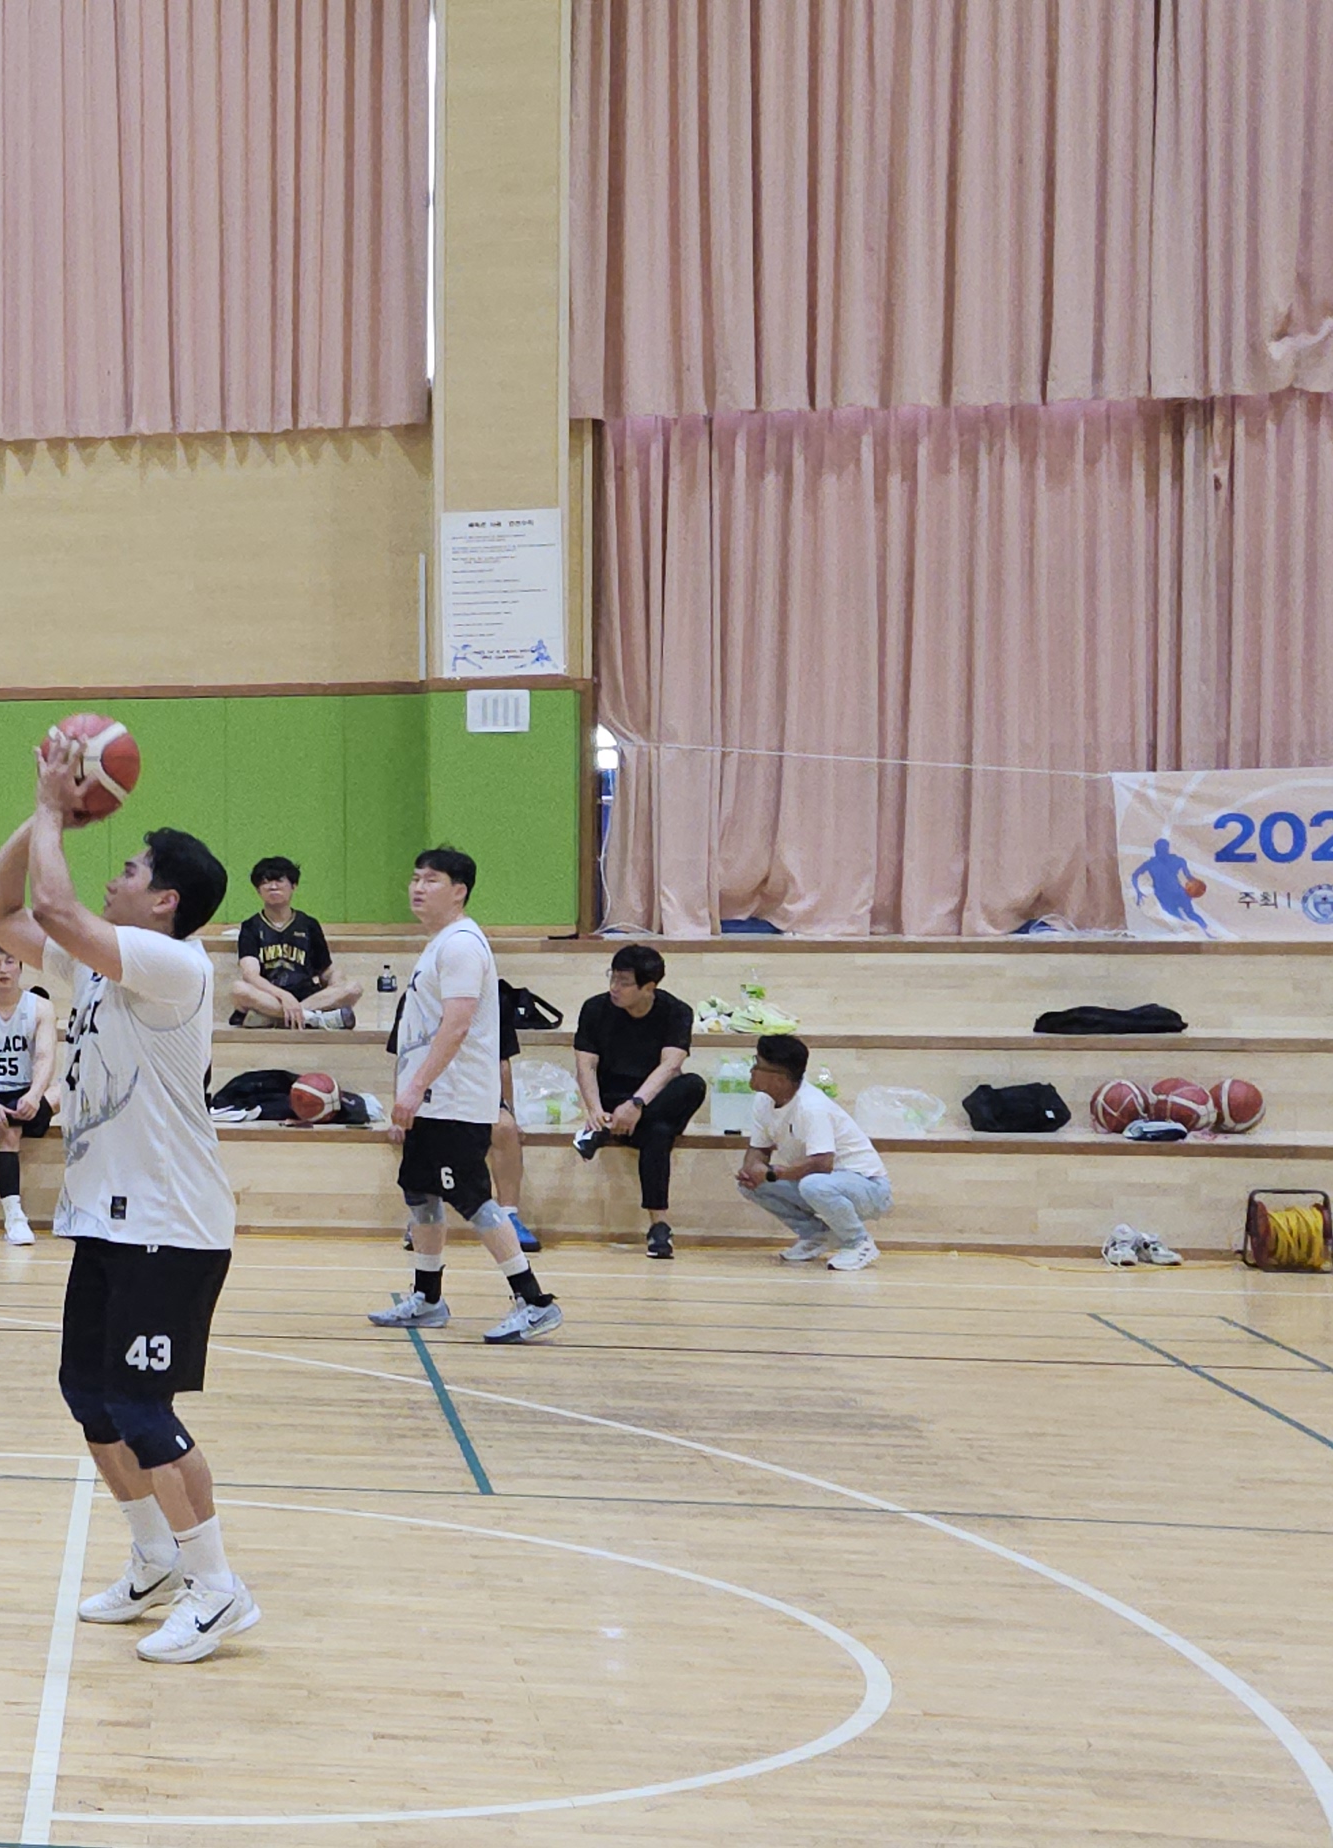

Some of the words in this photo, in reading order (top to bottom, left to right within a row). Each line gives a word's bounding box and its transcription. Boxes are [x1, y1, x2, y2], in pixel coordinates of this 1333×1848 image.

[1237, 891, 1278, 909] 주최
[440, 1166, 455, 1190] 6
[125, 1334, 171, 1371] 43
